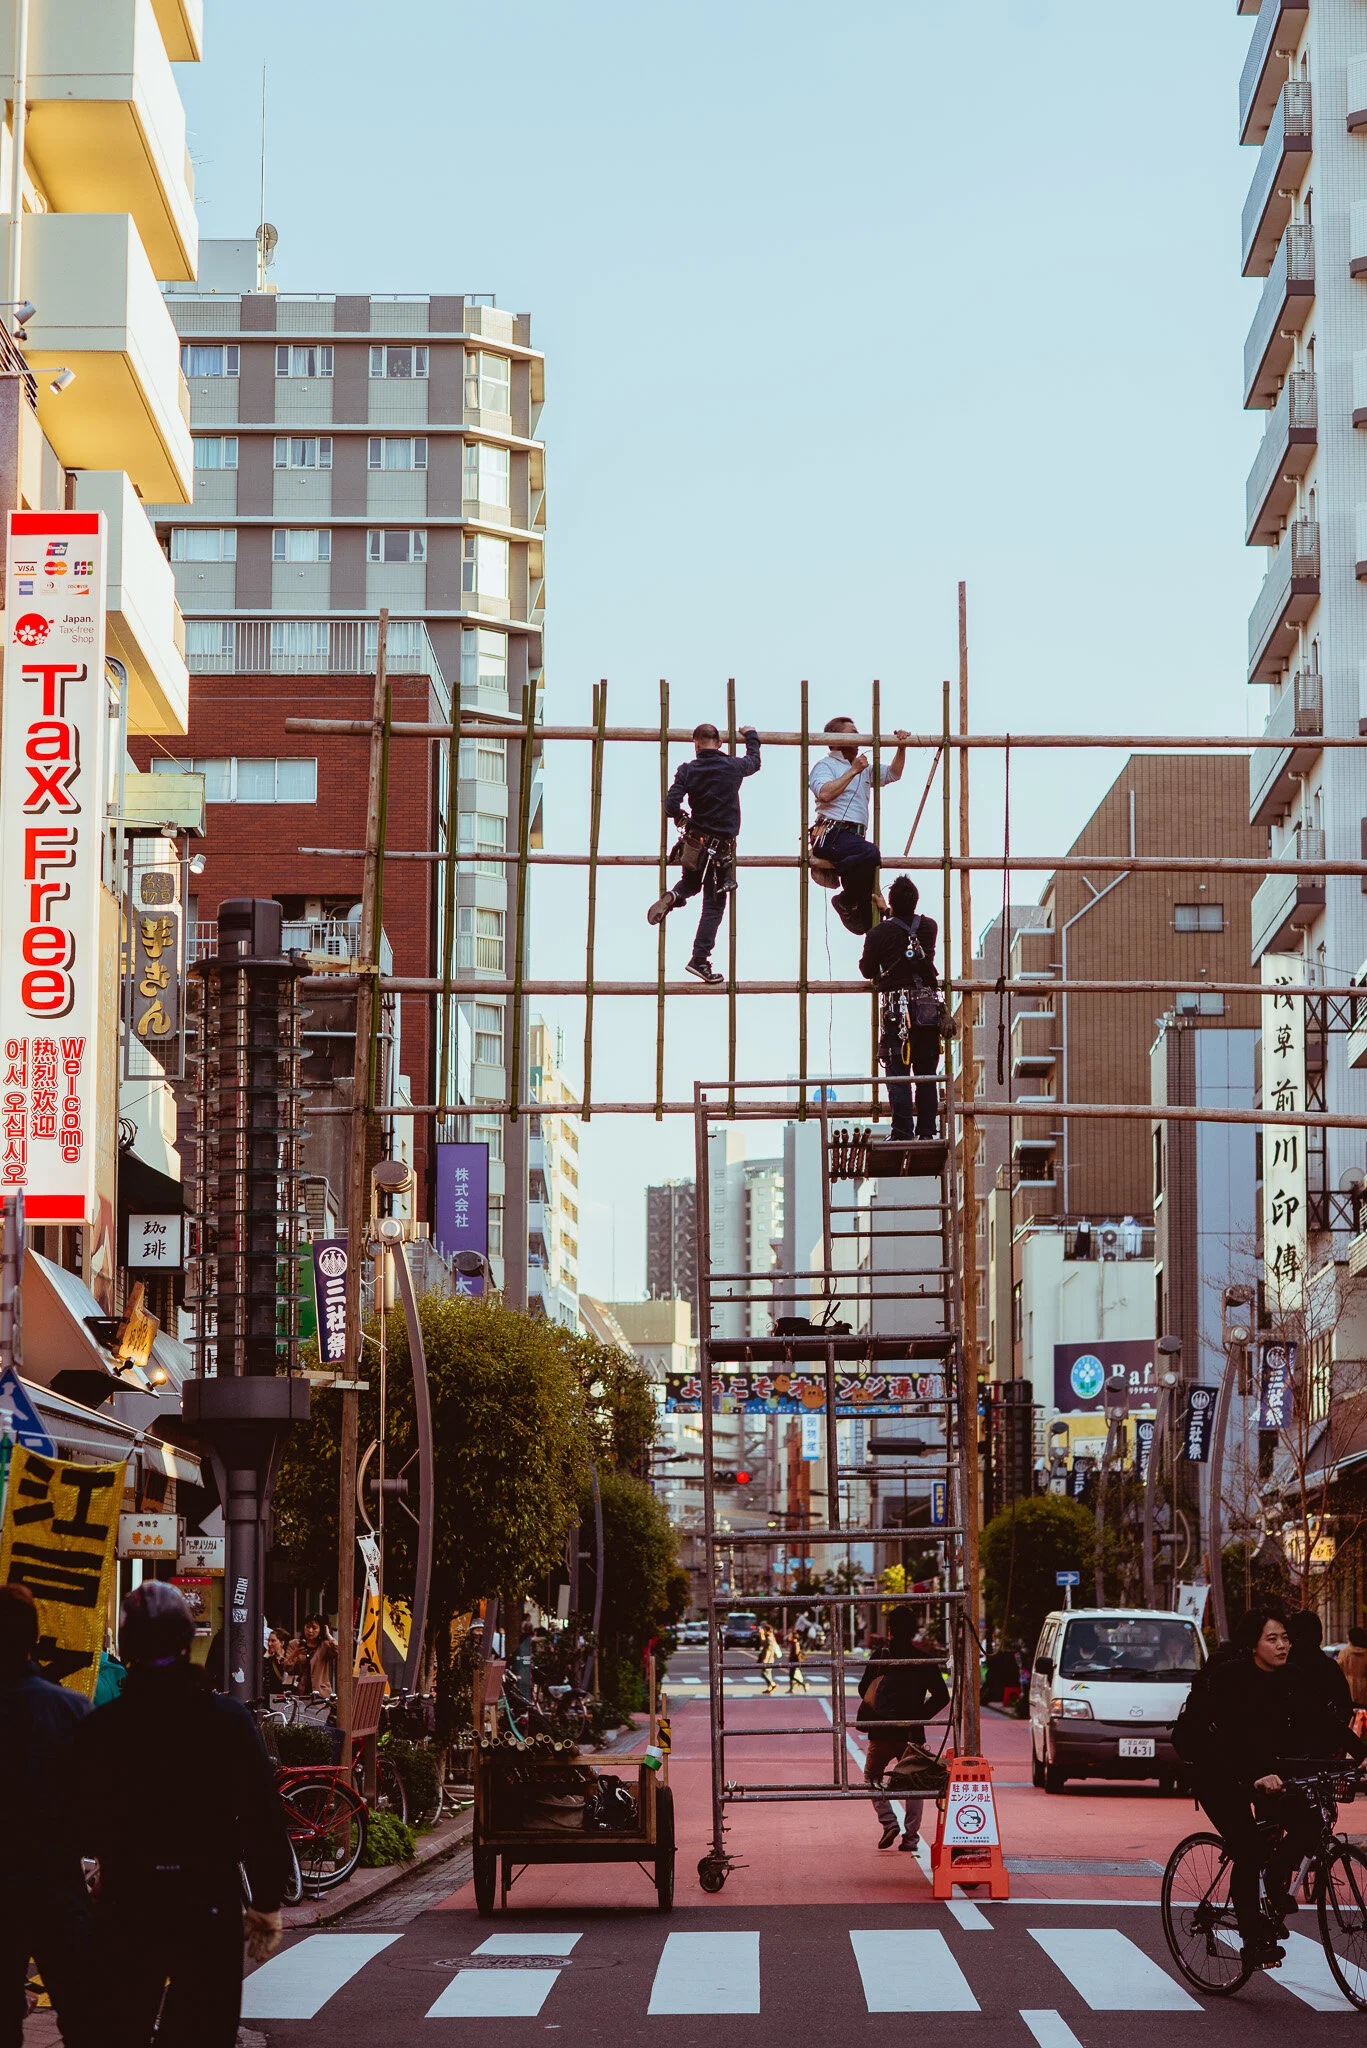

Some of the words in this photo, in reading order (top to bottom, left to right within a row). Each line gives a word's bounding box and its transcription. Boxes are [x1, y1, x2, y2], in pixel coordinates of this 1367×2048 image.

[59, 625, 94, 634] Tax-free
[62, 614, 94, 624] Japan.
[71, 634, 94, 644] Shop
[22, 664, 87, 814] Tax
[21, 826, 79, 1019] Free
[4, 1037, 30, 1088] 어서
[31, 1037, 58, 1141] 热烈欢迎
[59, 1037, 86, 1164] Welcome
[1, 1091, 29, 1187] 오십시오
[454, 1167, 470, 1228] 株式会社
[142, 1220, 167, 1260] 珈琲
[325, 1277, 347, 1359] 三社祭
[1266, 1369, 1285, 1426] 三社祭
[1188, 1410, 1205, 1460] 三社祭
[233, 1577, 248, 1606] RULER
[1127, 1746, 1152, 1756] 14-31
[950, 1793, 991, 1802] エンジン停止
[952, 1784, 989, 1793] 駐停車時
